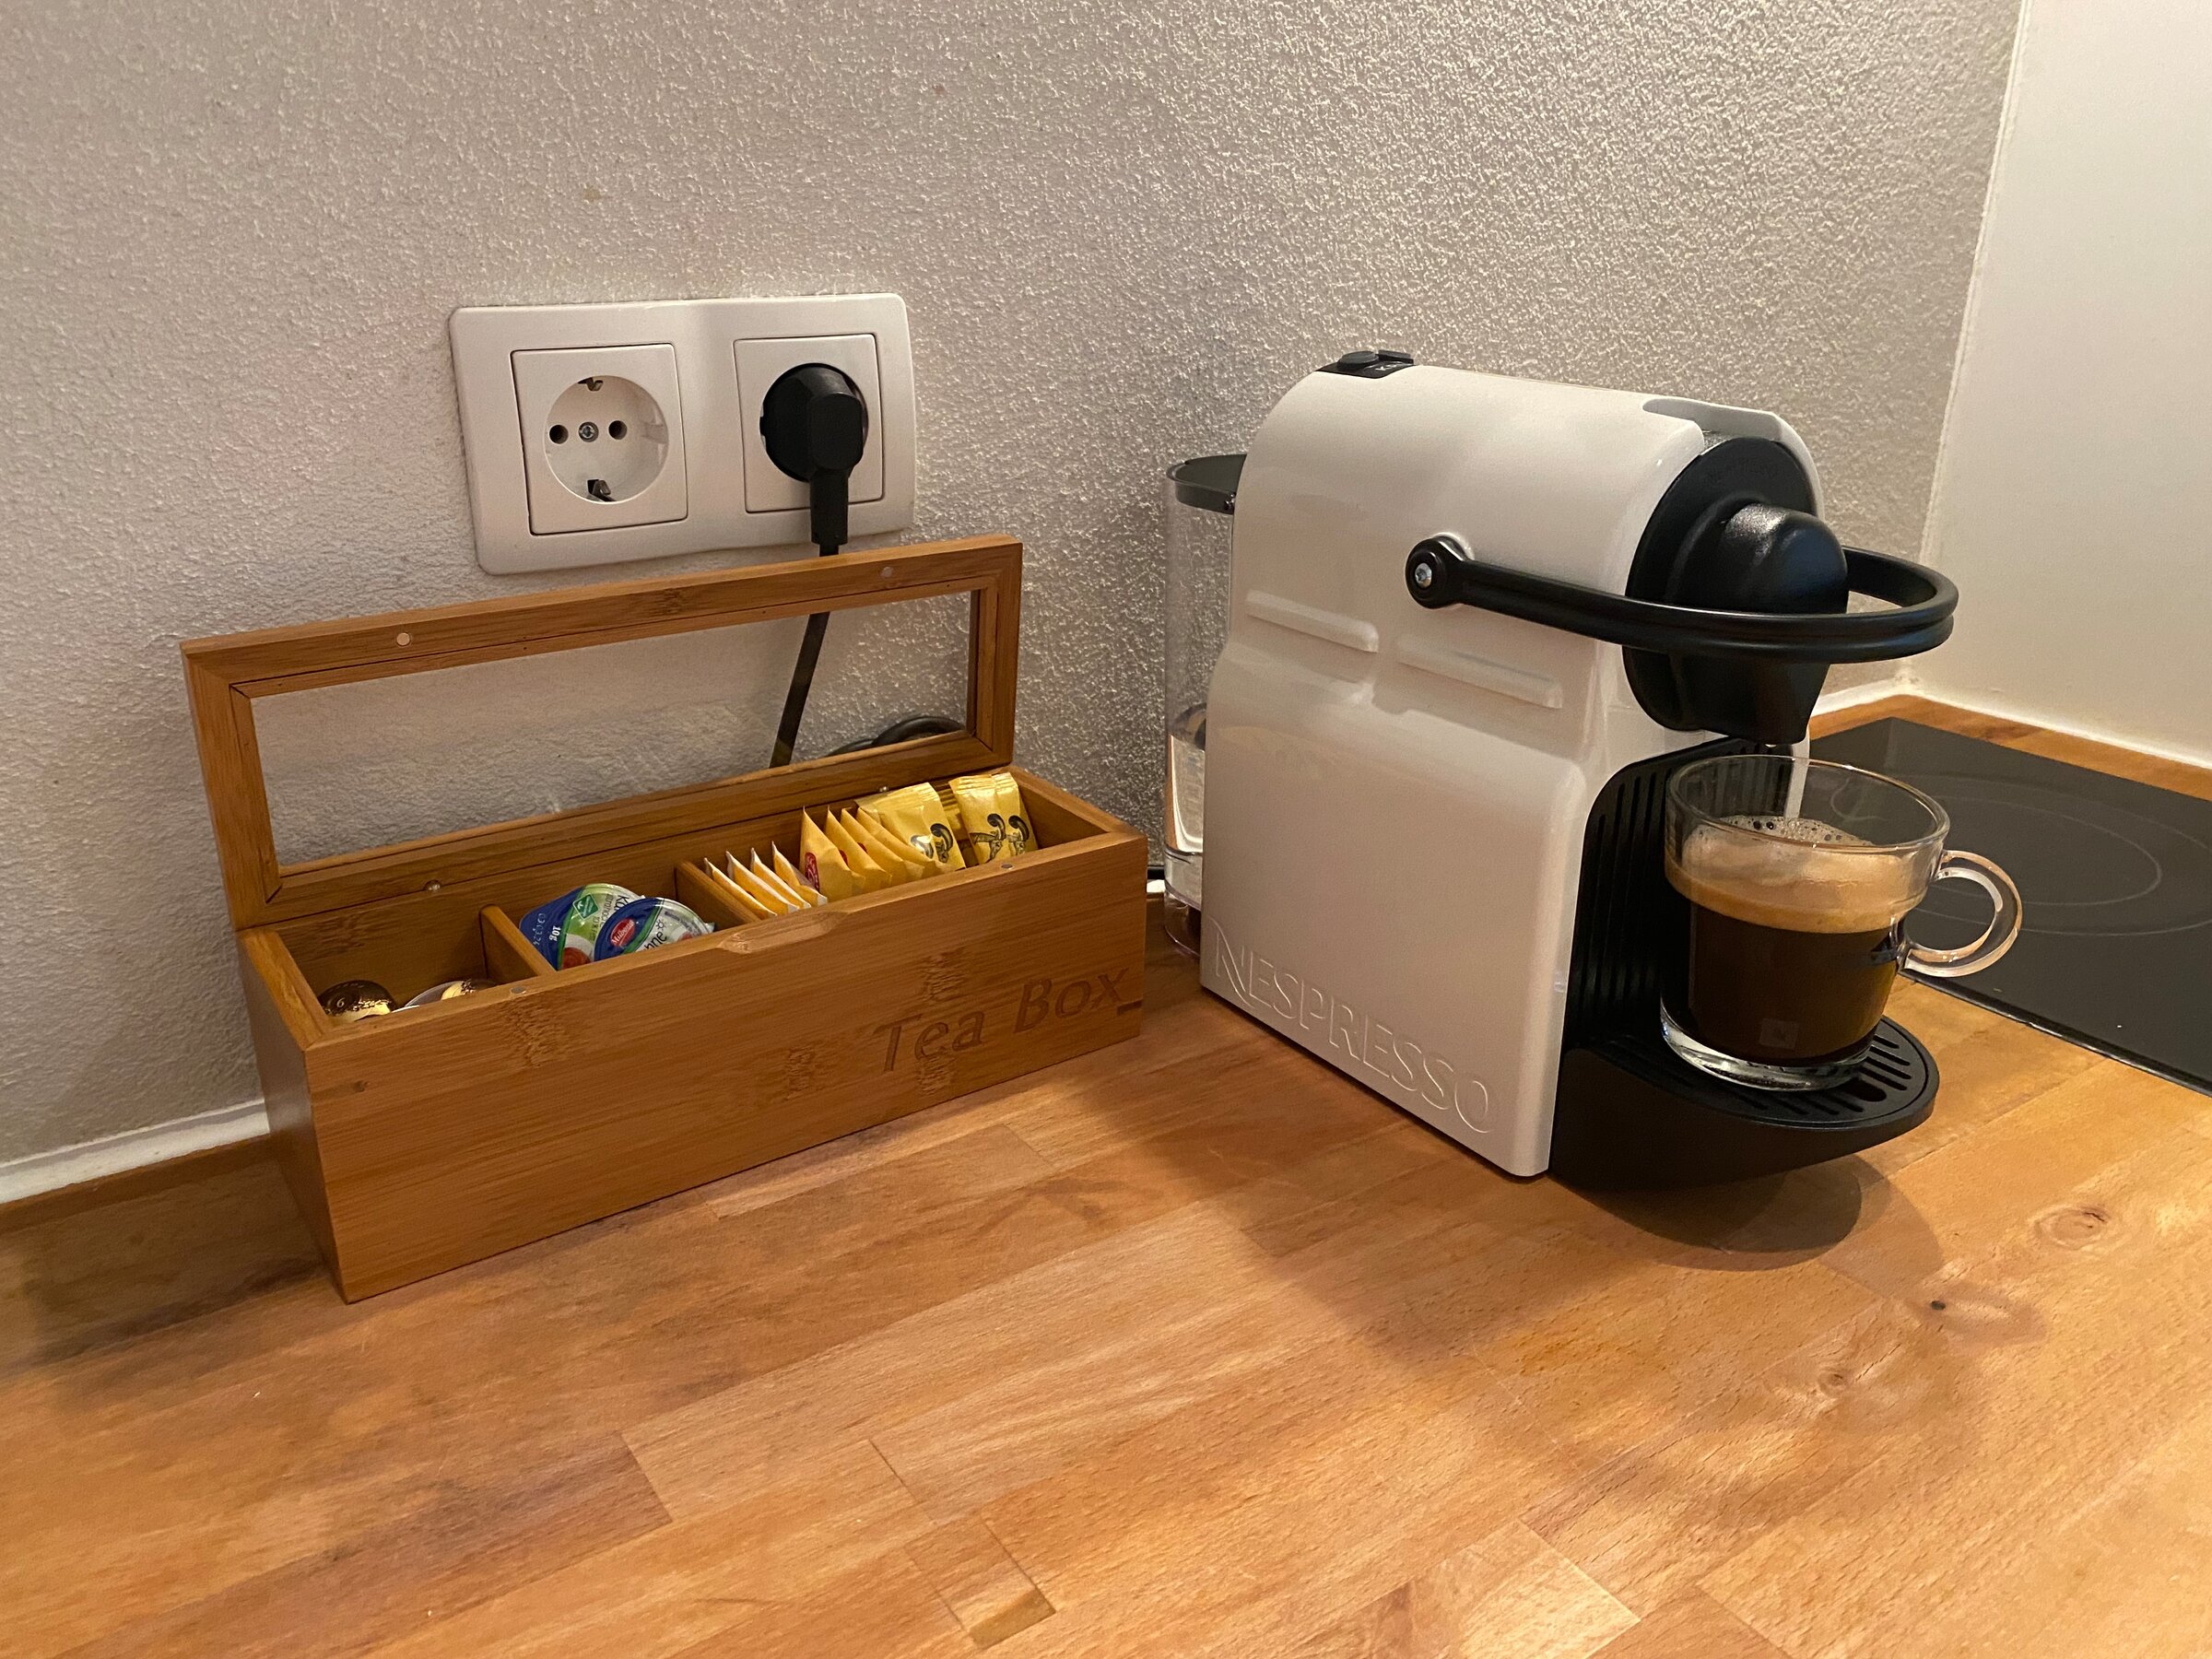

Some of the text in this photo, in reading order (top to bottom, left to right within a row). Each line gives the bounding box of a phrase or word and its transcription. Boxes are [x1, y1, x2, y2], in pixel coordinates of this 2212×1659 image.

[548, 925, 561, 942] 10g
[872, 968, 1130, 1072] Tea Box
[1206, 915, 1491, 1134] NESPRESSO
